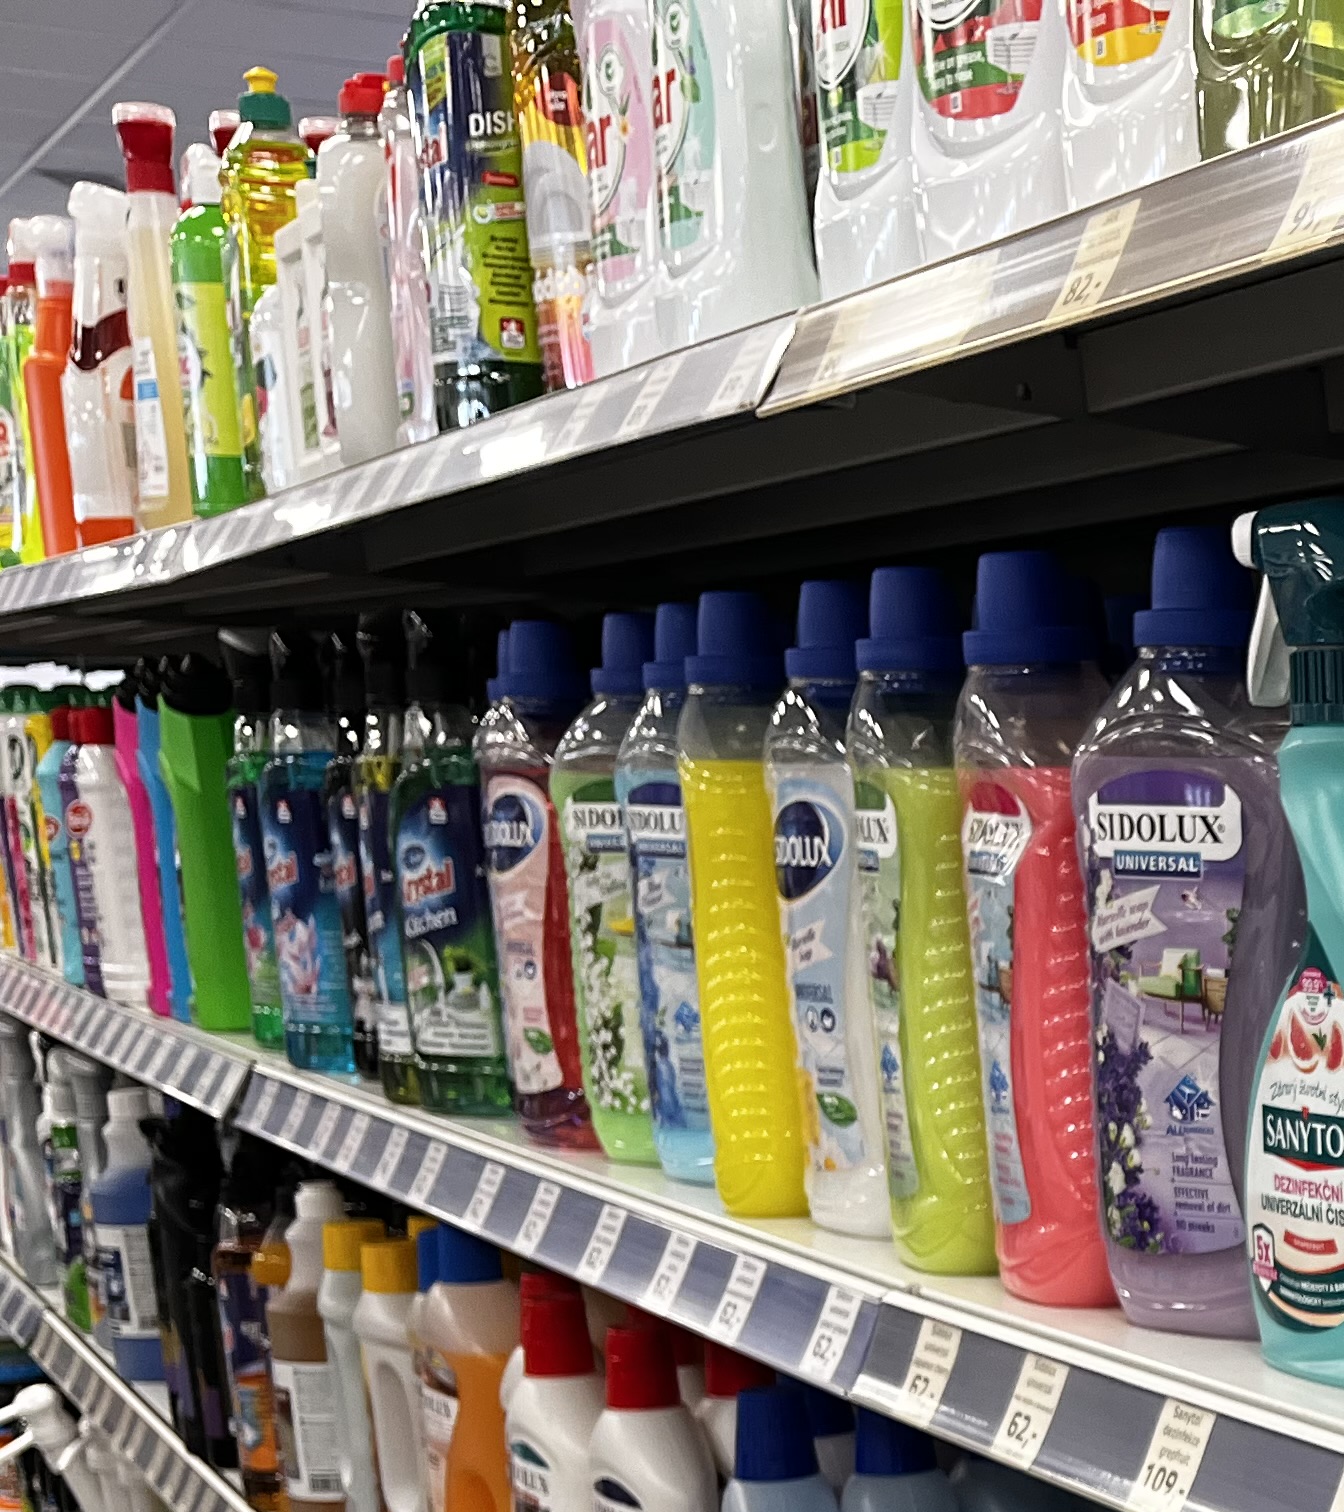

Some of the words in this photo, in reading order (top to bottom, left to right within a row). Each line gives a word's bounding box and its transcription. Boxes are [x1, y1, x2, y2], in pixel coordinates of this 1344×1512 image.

[651, 67, 677, 126] ar
[587, 114, 612, 171] ar
[1097, 813, 1223, 844] SIDOLUX
[775, 835, 832, 868] DOLUX
[1115, 855, 1199, 873] UNIVERSAL
[1274, 1173, 1344, 1203] DEZINFEKČNÍ
[1261, 1193, 1323, 1222] UNIVERZÁLNÍ
[1007, 1411, 1037, 1449] 62,-
